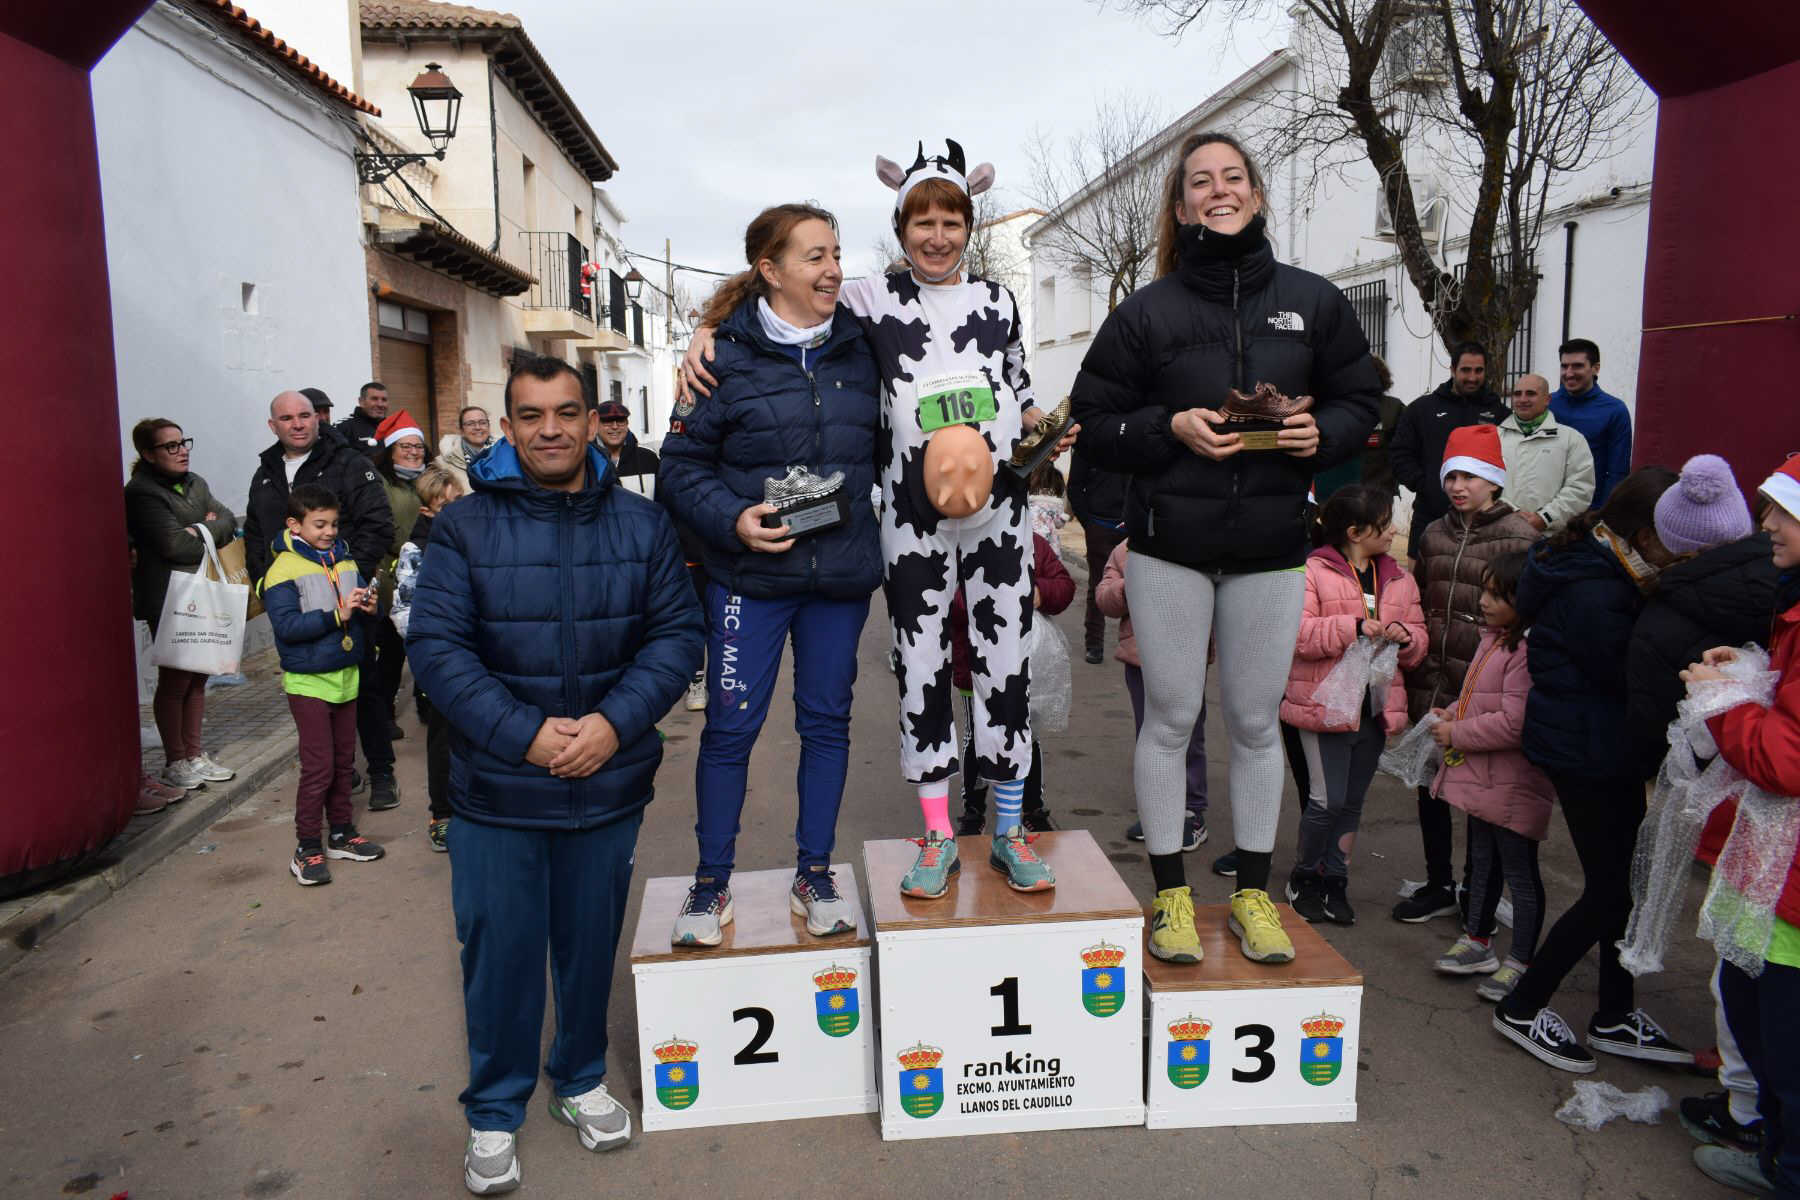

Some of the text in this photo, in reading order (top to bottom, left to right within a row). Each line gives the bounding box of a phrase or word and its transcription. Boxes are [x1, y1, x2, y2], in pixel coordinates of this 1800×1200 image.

[936, 390, 976, 423] 116
[990, 977, 1032, 1036] 1
[732, 1006, 779, 1065] 2
[963, 1050, 1061, 1077] ranking
[1231, 1023, 1276, 1083] 3
[957, 1076, 1075, 1095] EXCMO. AYUNTAMIENTO
[960, 1094, 1073, 1114] LLANOS DEL CAUDILLO
